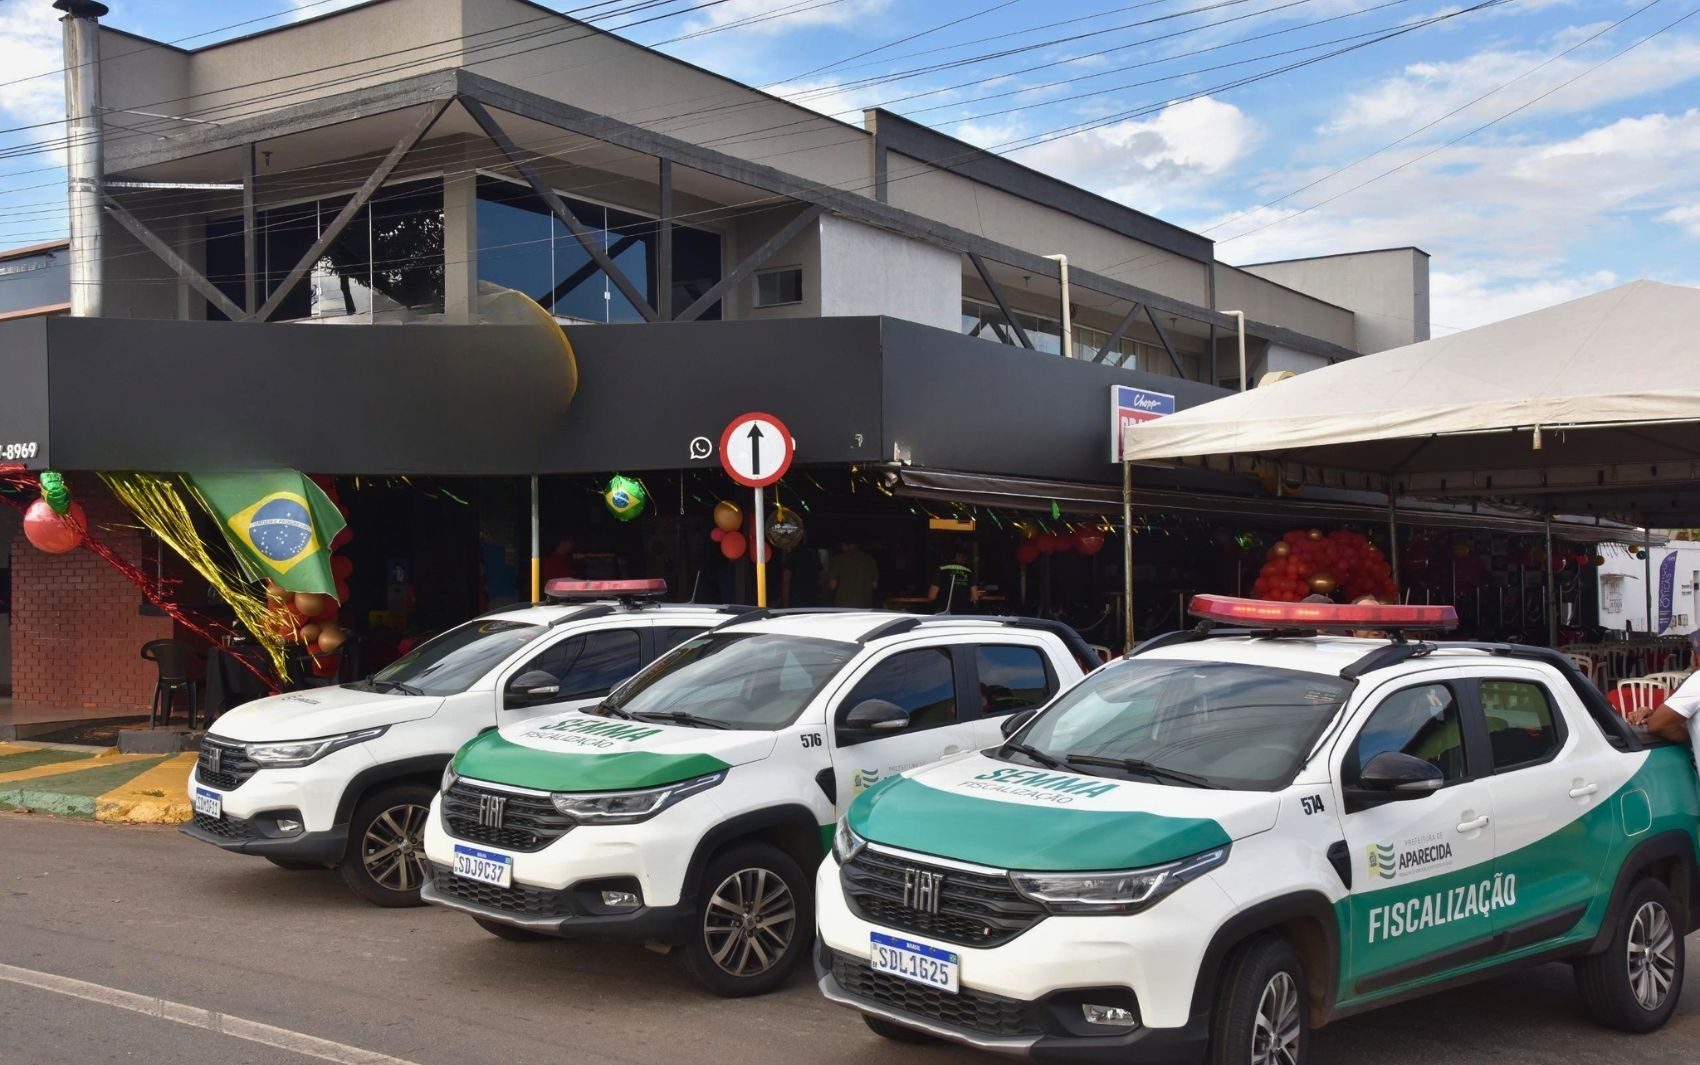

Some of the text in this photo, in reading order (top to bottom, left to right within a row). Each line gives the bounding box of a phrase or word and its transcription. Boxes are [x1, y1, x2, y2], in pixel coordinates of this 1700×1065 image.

[1134, 394, 1161, 410] Chopp
[0, 442, 37, 460] -8969
[520, 731, 614, 748] FISCALIZAÇÃO
[539, 719, 664, 742] SEMMA
[800, 733, 822, 748] 576
[957, 780, 1074, 804] FISCALIZAÇÃO
[975, 768, 1120, 798] SEMMA
[479, 794, 507, 829] FIAT
[1301, 794, 1325, 815] 574
[1399, 842, 1452, 870] APARECIDA
[458, 856, 504, 883] SDJ9C37
[904, 868, 943, 914] FIAT
[1368, 872, 1516, 943] FISCALIZAÇÃO
[879, 947, 949, 985] SDL1G25
